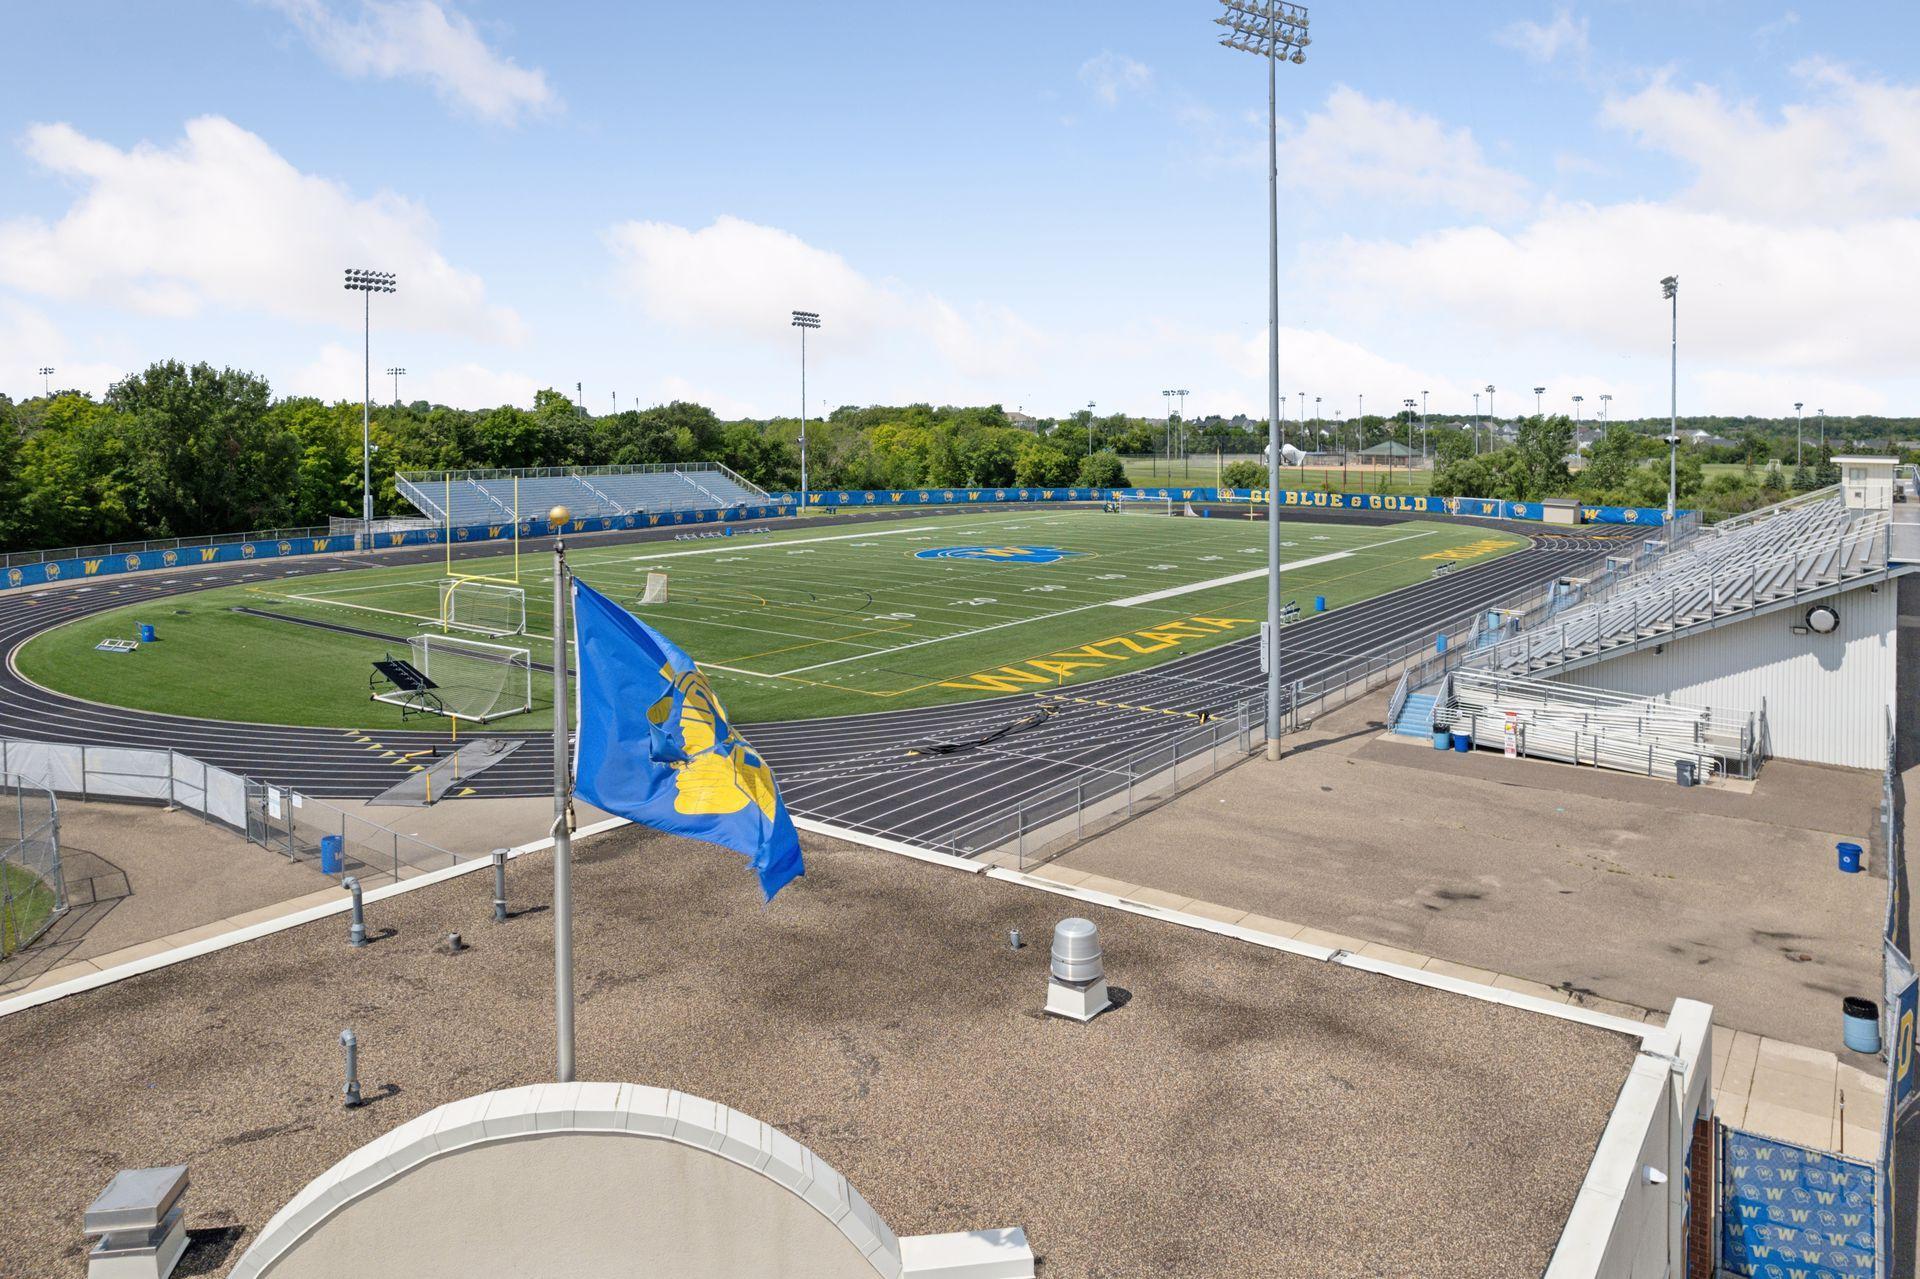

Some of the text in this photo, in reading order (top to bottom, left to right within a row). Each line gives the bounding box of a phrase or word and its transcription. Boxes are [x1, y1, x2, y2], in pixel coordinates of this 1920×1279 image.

[1285, 491, 1344, 507] BLUE
[1369, 495, 1428, 511] GOLD
[313, 539, 331, 551] W
[200, 548, 219, 561] W
[83, 559, 103, 574] W
[937, 616, 1257, 692] WAYZATA
[1753, 1148, 1776, 1160] W
[1776, 1168, 1799, 1181] W
[1827, 1172, 1852, 1186] W
[1763, 1187, 1787, 1200] W
[1815, 1191, 1838, 1205] W
[1739, 1205, 1761, 1218] W
[1788, 1208, 1812, 1223] W
[1840, 1213, 1866, 1227] W
[1728, 1223, 1749, 1236] W
[1774, 1227, 1798, 1241] W
[1826, 1232, 1851, 1246] W
[1749, 1245, 1773, 1258] W
[1799, 1250, 1825, 1264] W
[1852, 1254, 1875, 1268] W
[1737, 1263, 1760, 1276] W
